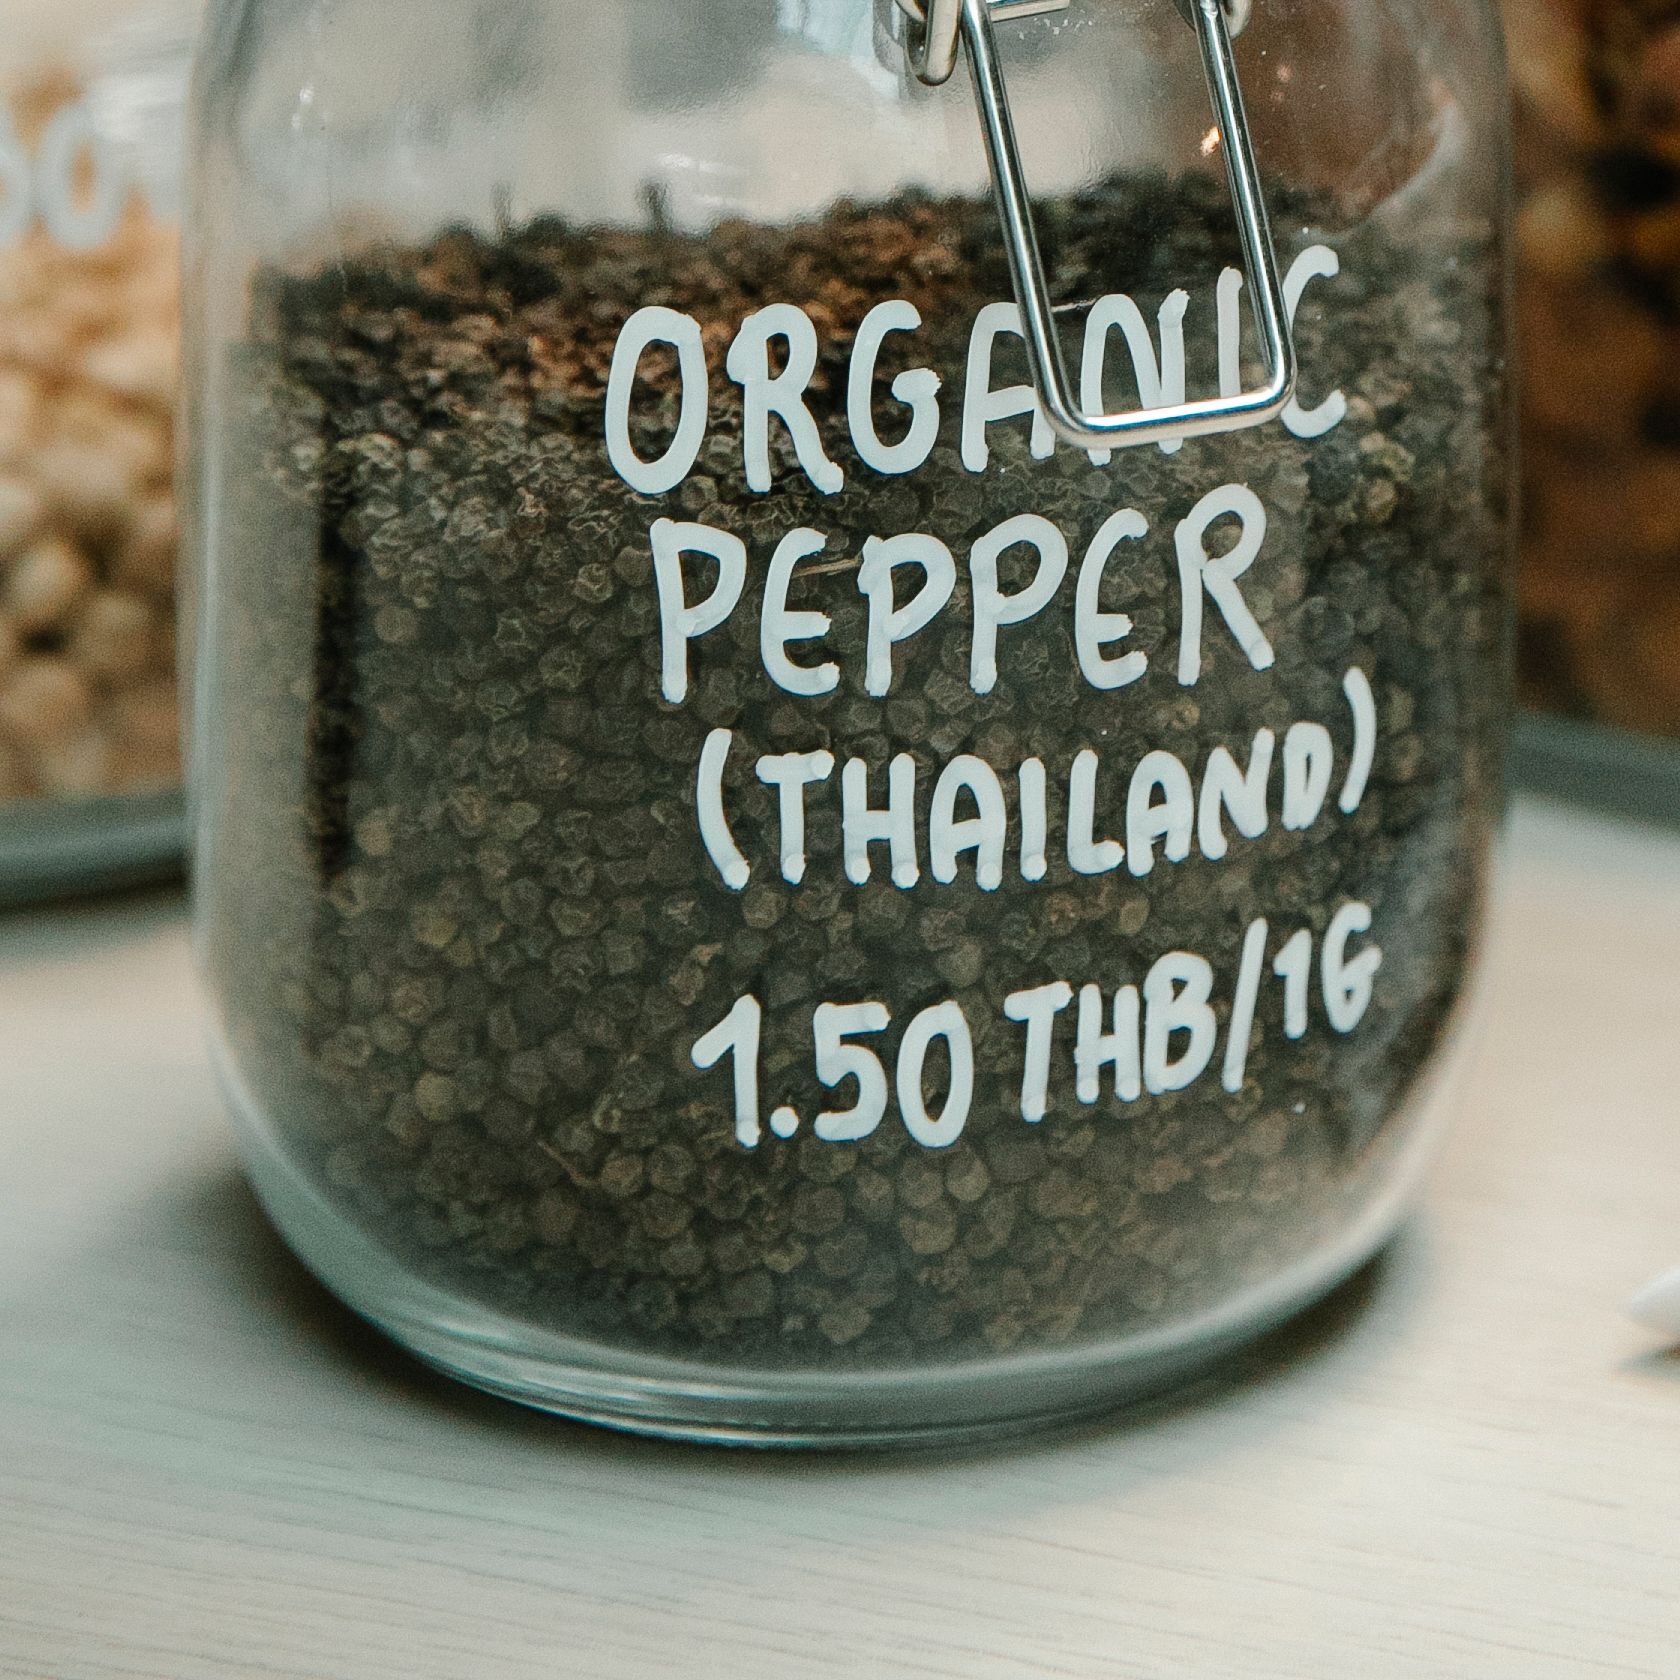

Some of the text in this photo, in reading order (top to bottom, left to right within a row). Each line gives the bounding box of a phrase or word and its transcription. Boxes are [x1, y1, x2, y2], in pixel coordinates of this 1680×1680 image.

[604, 243, 1348, 496] ORGANIC
[650, 482, 1276, 704] PEPPER
[696, 667, 1377, 892] (THAILAND)
[691, 902, 1383, 1148] 1.50 THB/1G
